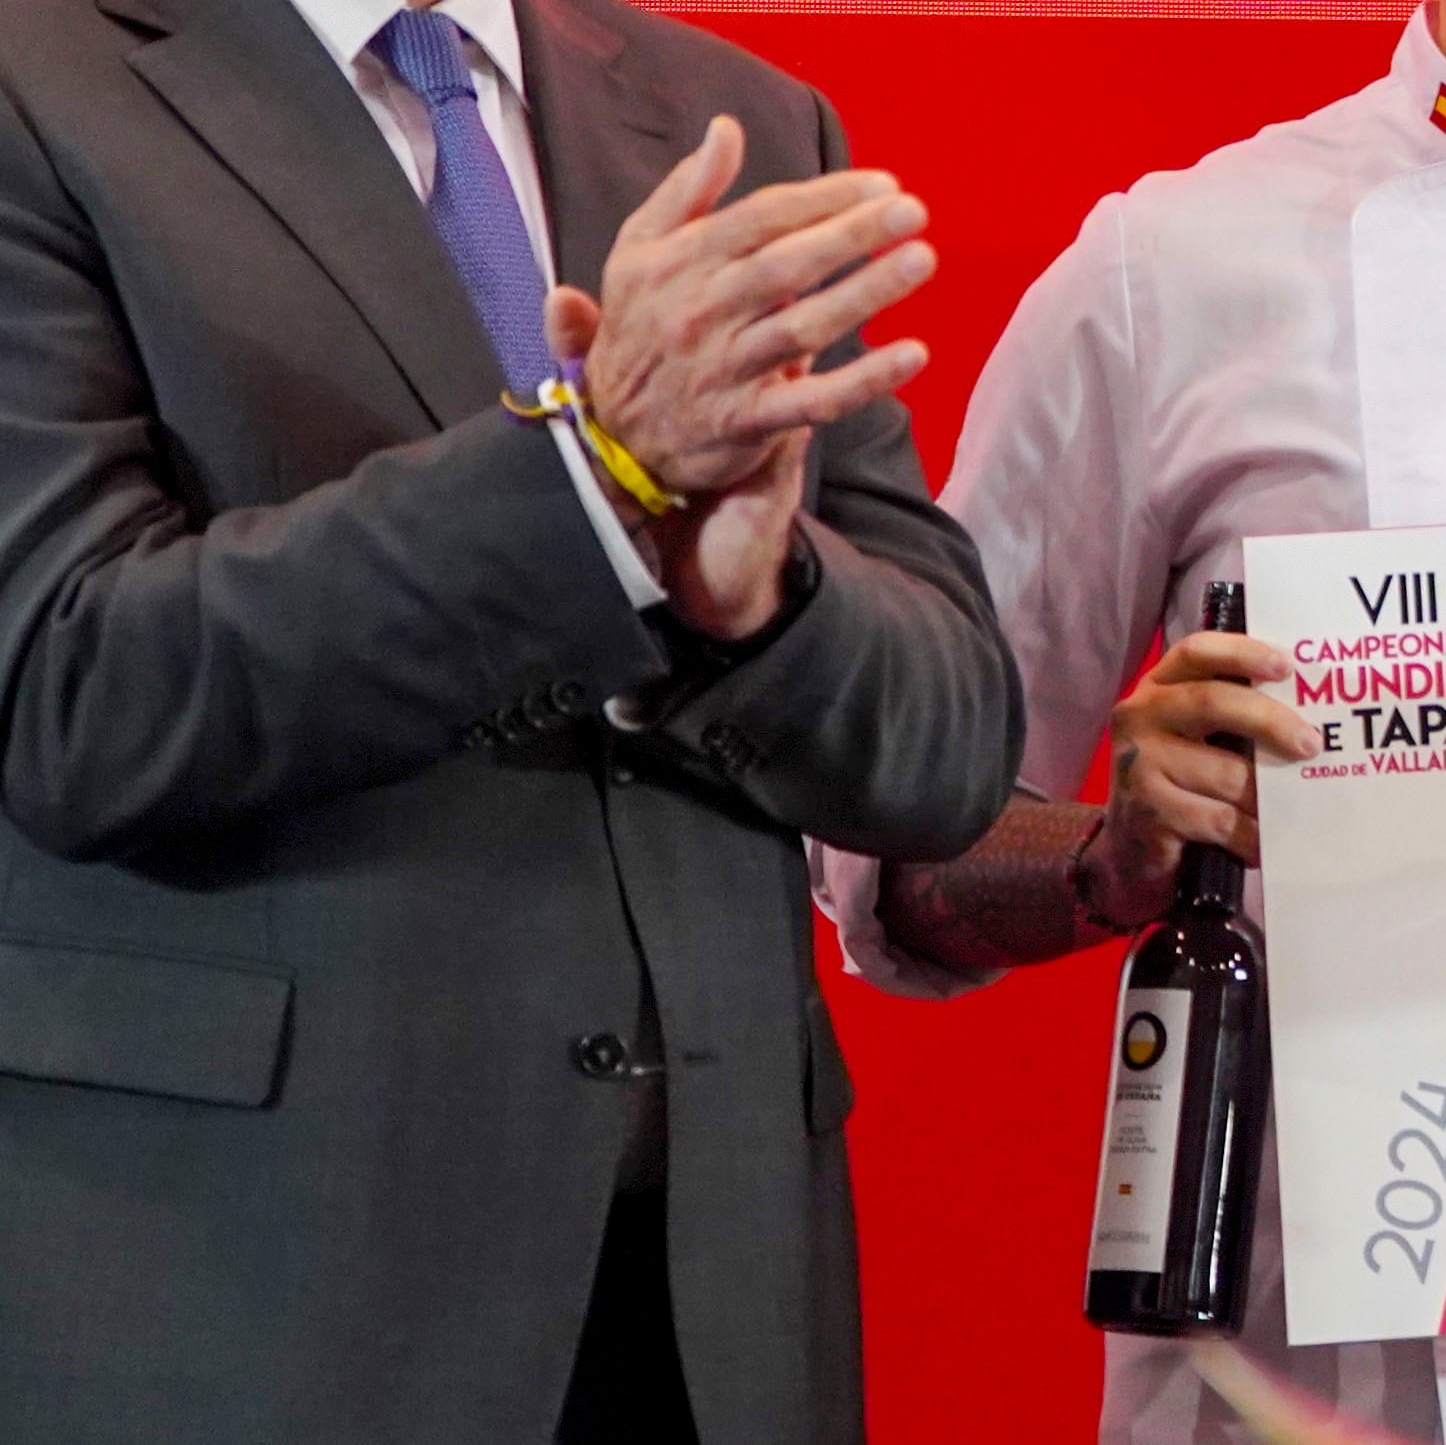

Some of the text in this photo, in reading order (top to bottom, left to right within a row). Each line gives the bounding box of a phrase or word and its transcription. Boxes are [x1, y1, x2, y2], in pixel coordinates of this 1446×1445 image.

[1349, 571, 1438, 627] VIII
[1312, 722, 1343, 752] E
[1301, 764, 1348, 779] CIUDAD
[1351, 763, 1368, 775] DE
